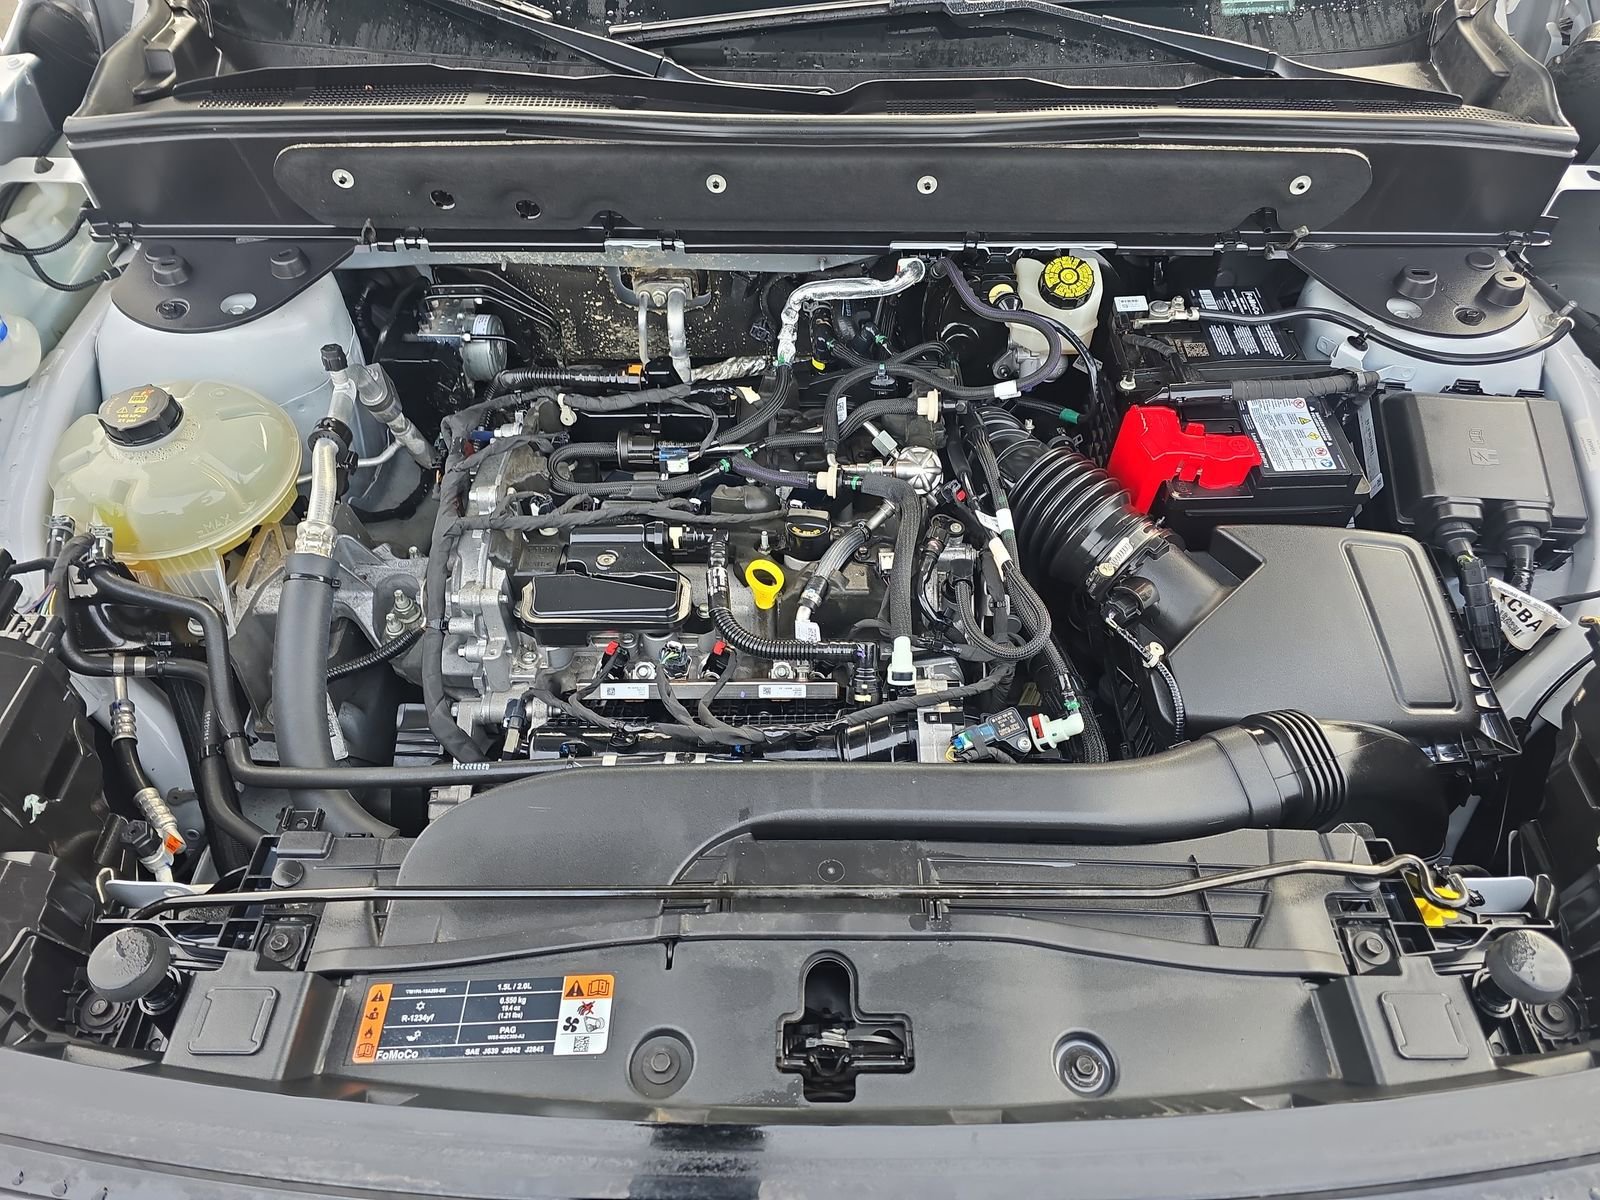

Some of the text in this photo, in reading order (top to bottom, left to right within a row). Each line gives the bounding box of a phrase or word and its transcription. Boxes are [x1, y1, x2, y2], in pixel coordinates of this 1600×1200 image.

[497, 983, 511, 991] 1.5L
[516, 982, 532, 990] 2.0L
[499, 996, 527, 1005] 0.550 kg
[401, 1013, 435, 1023] R-1234yf
[499, 1026, 517, 1034] PAG
[375, 1048, 419, 1060] FoMoCo
[464, 1048, 480, 1056] SAE
[524, 1045, 544, 1053] J2845
